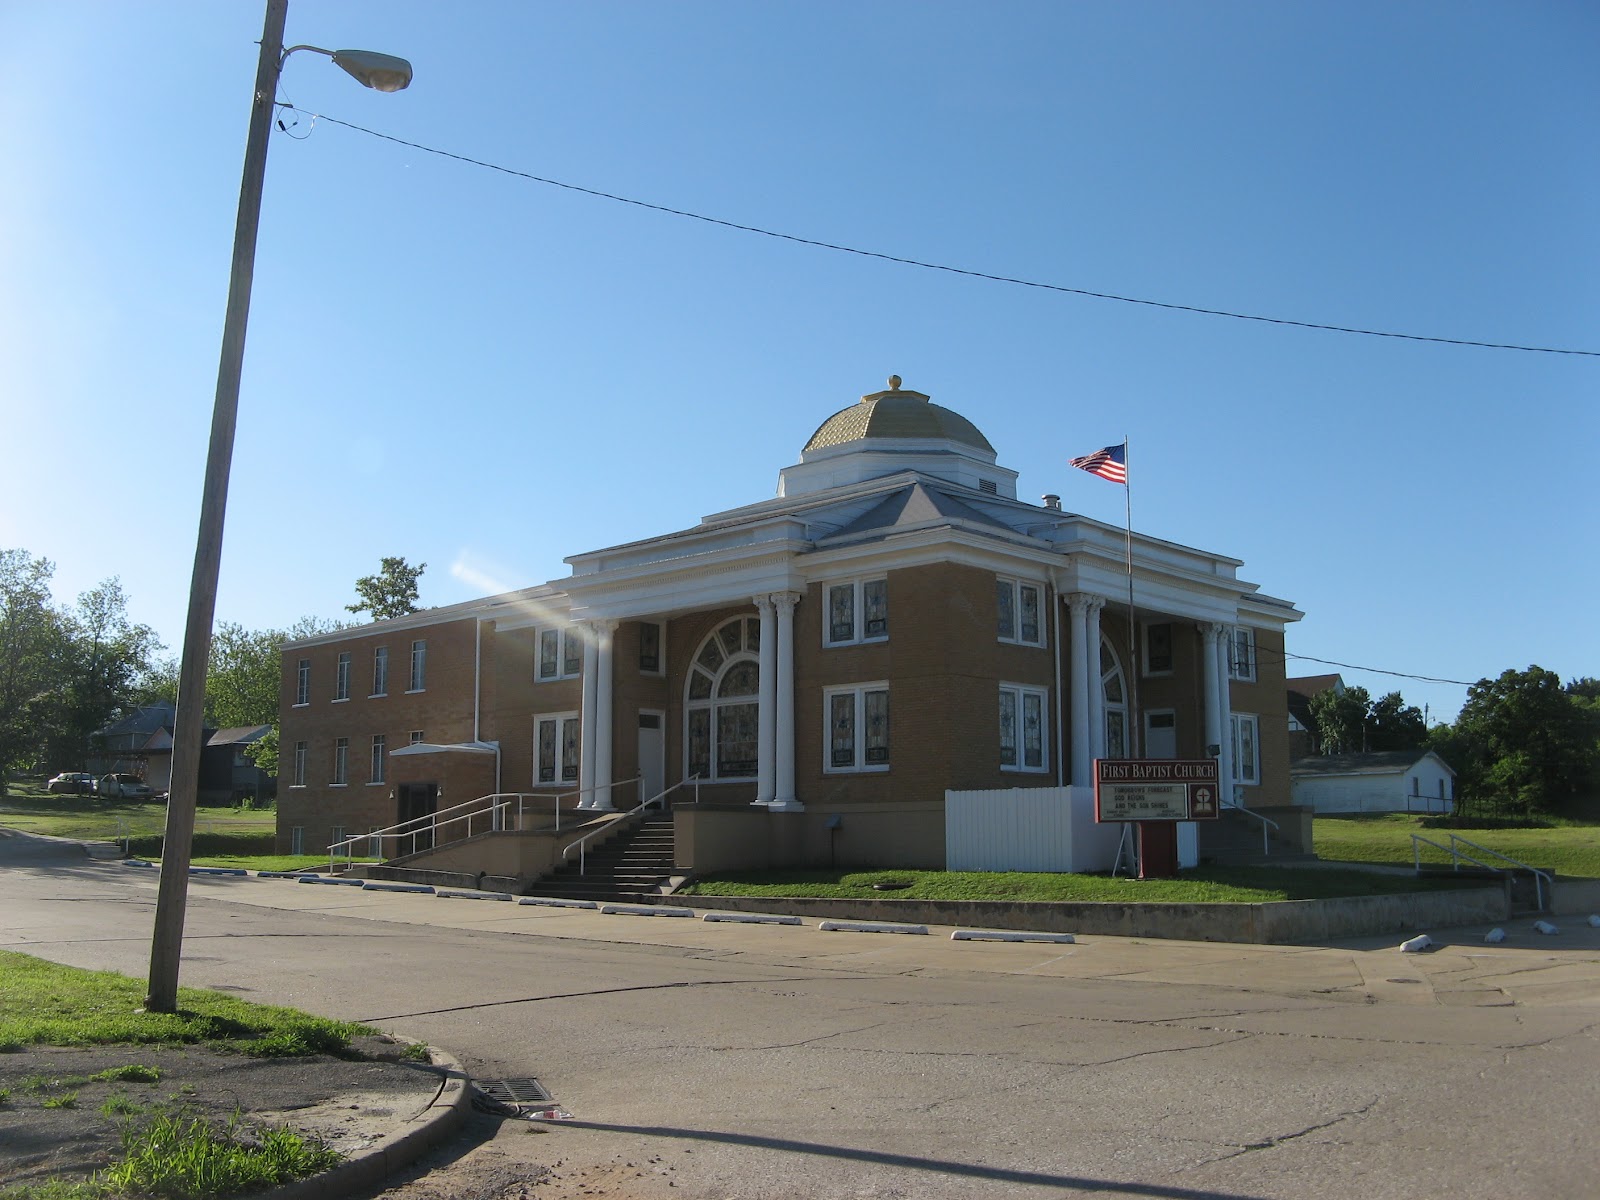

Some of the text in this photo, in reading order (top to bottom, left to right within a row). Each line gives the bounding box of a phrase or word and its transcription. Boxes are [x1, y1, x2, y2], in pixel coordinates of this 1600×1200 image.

[1102, 763, 1214, 778] FIRST BAPTIST CHURCH
